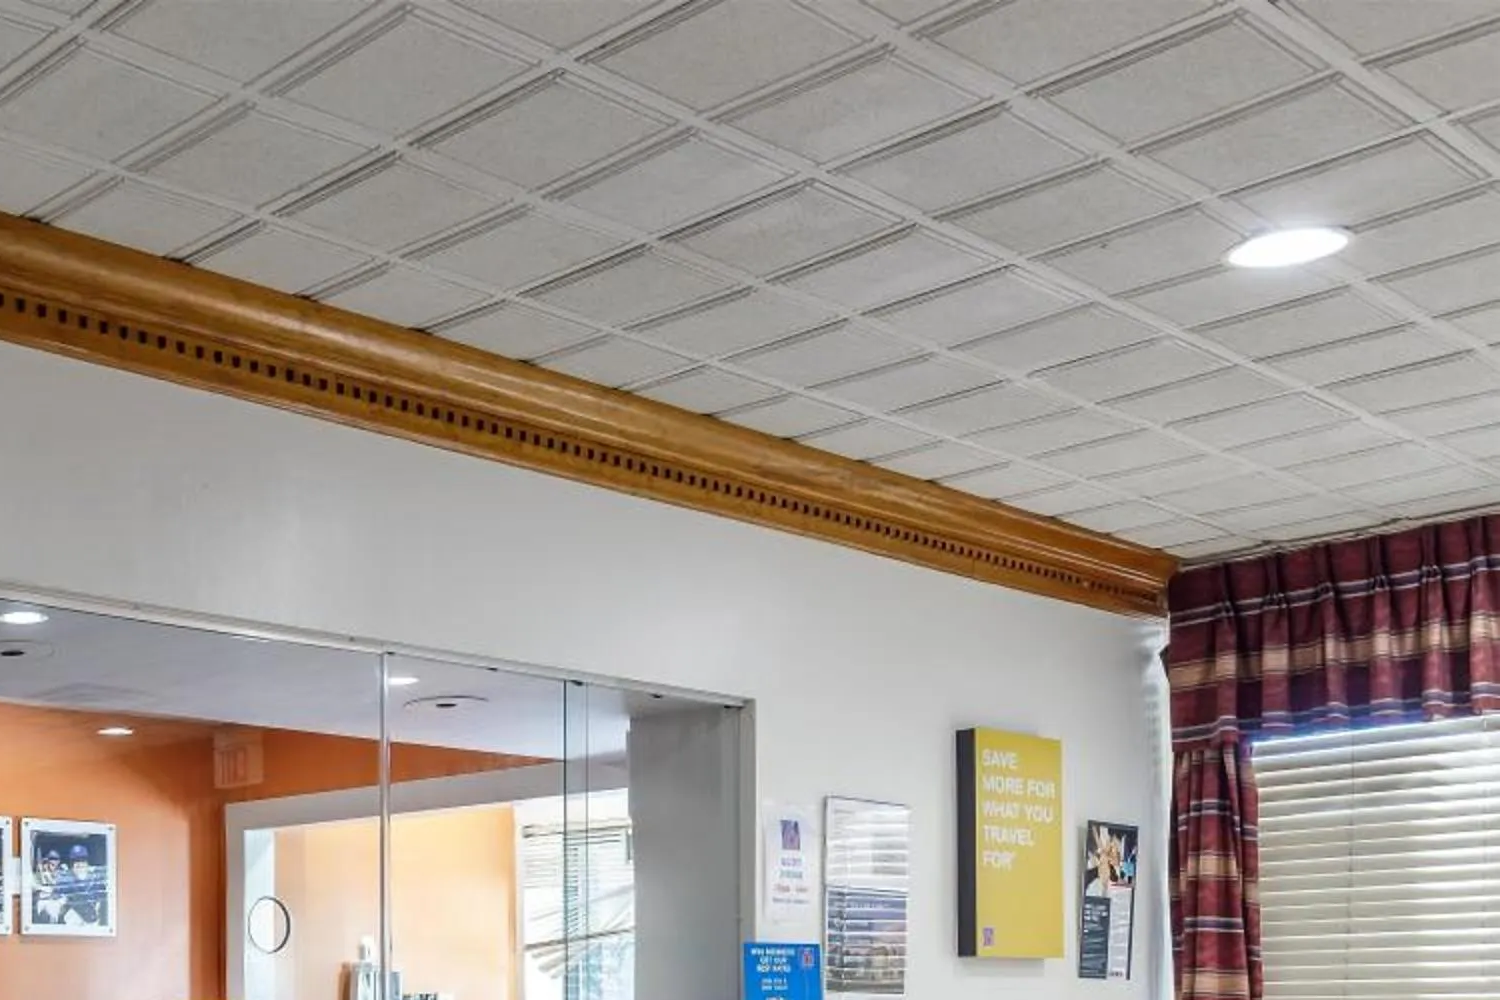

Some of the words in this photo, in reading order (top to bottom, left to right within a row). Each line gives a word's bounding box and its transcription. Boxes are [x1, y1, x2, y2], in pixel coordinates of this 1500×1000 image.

[982, 748, 1018, 769] SAVE
[983, 775, 1024, 796] MORE
[1027, 779, 1056, 799] FOR
[983, 801, 1020, 819] WHAT
[1024, 804, 1054, 823] YOU
[983, 825, 1035, 847] TRAVEL
